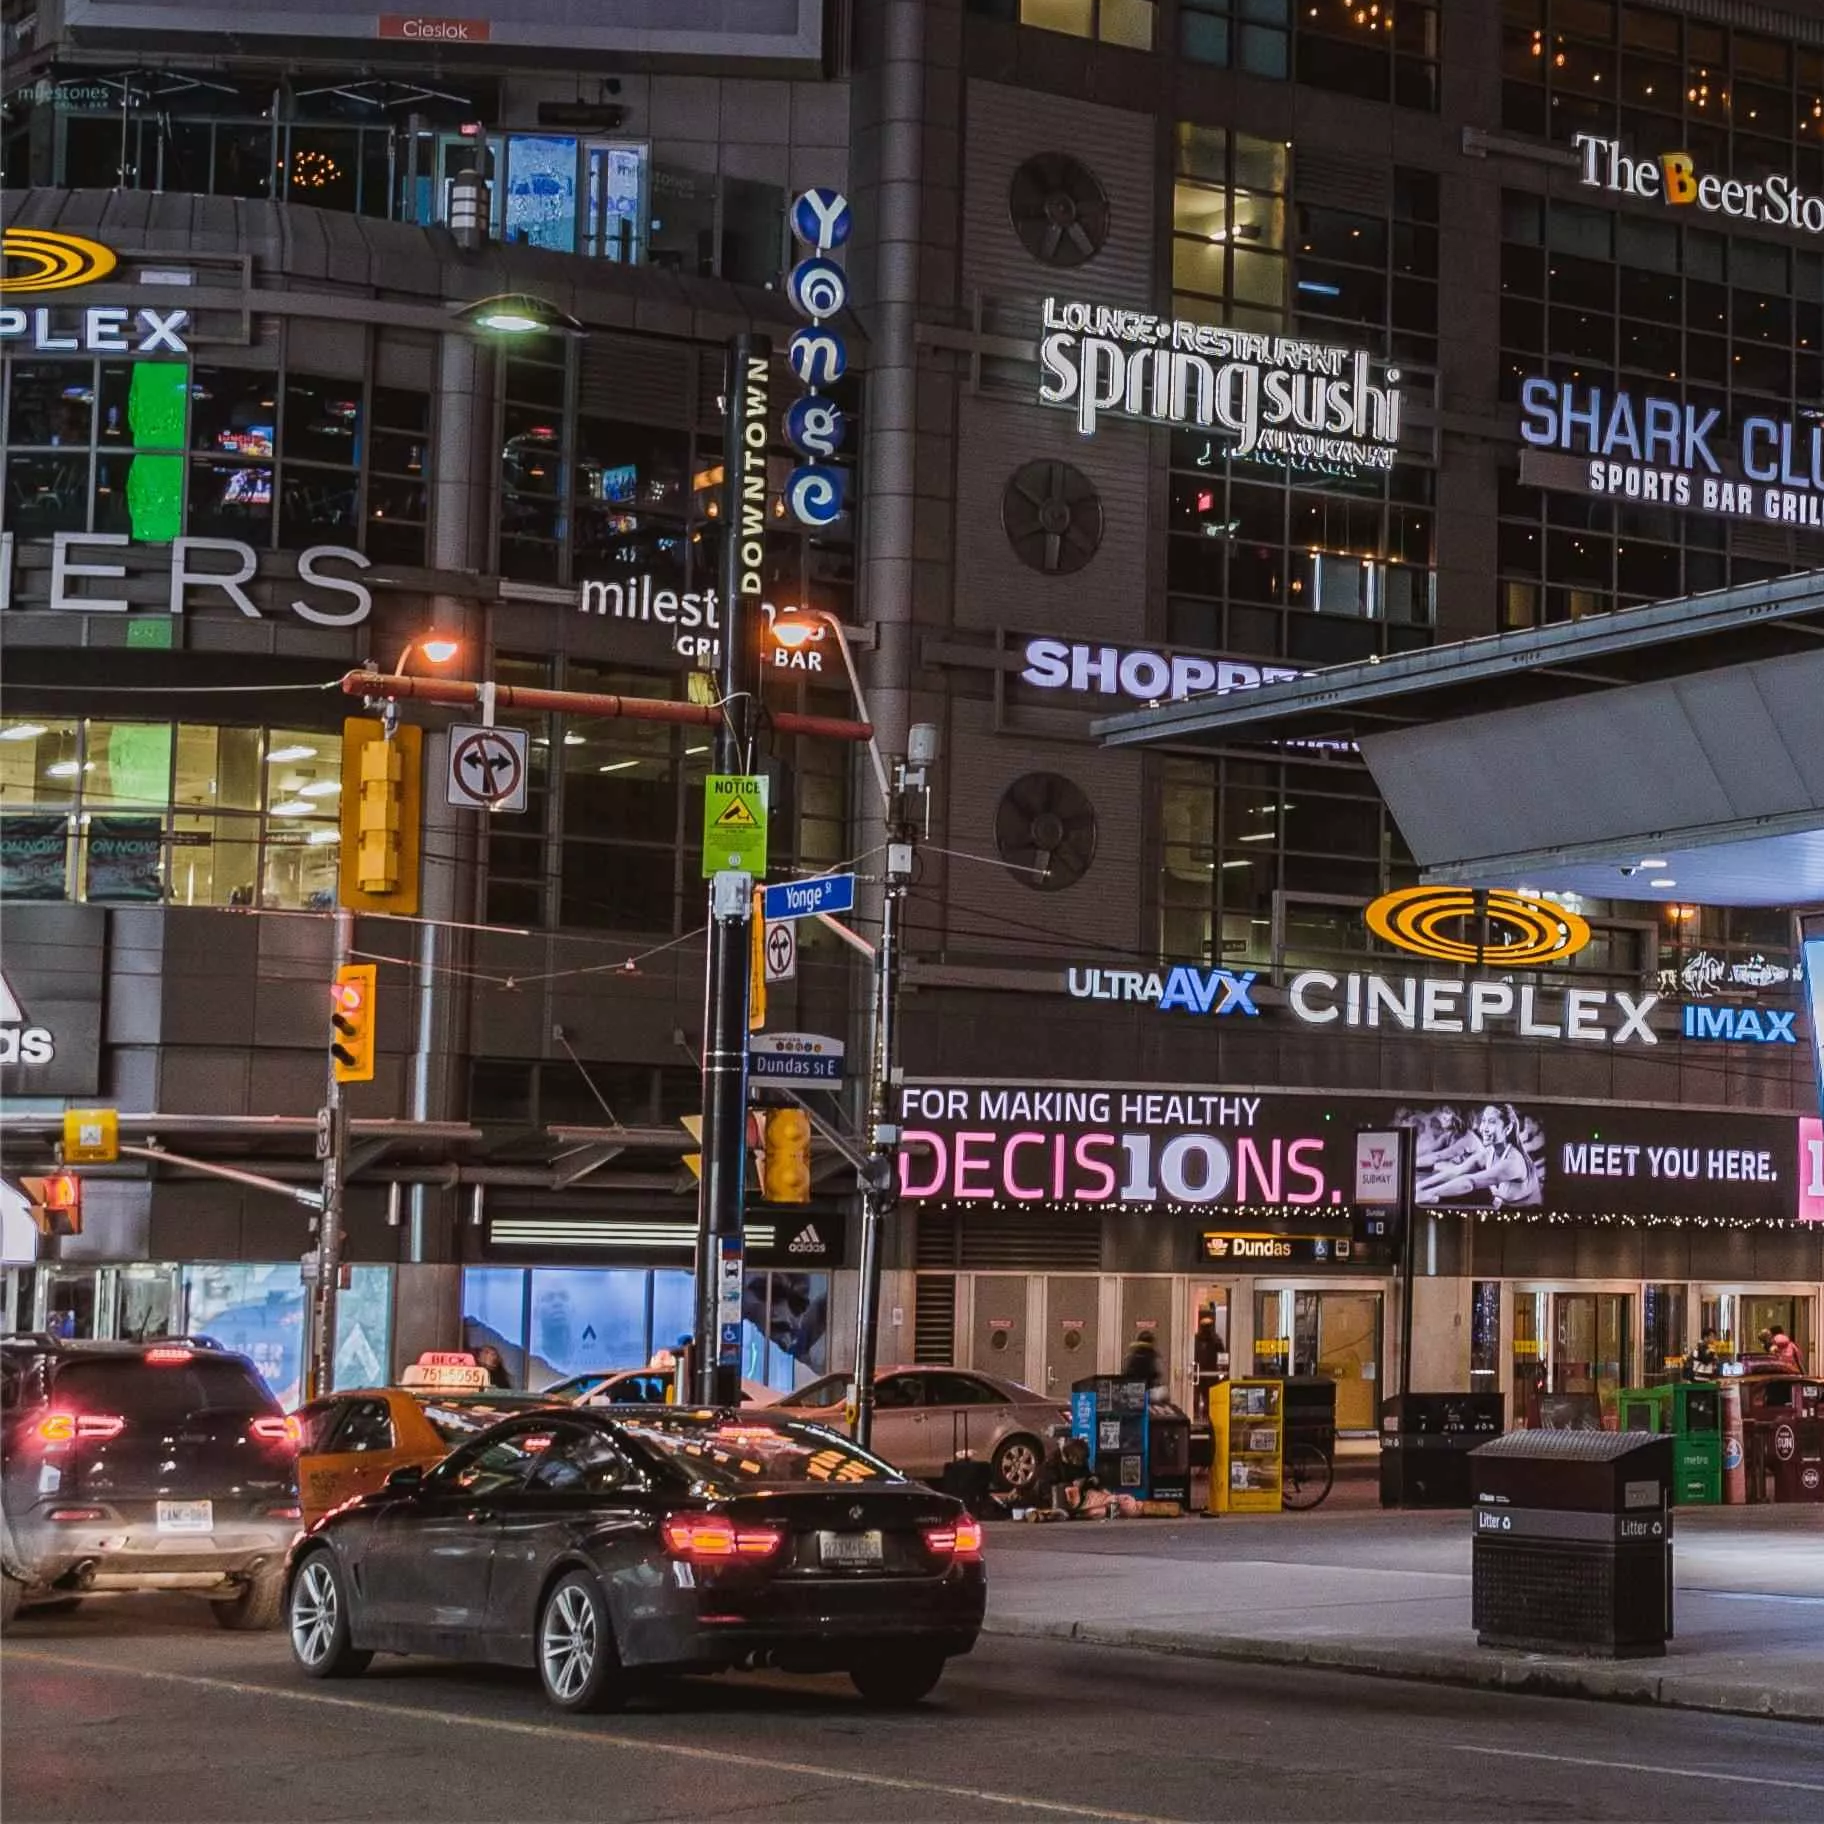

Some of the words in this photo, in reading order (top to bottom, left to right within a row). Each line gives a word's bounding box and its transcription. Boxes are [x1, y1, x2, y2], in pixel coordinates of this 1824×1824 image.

[402, 18, 468, 40] Cieslok
[1043, 296, 1158, 345] LOUNGE
[788, 187, 849, 526] Yonge
[1520, 377, 1721, 474] SHARK
[740, 356, 769, 595] DOWNTOWN
[1589, 459, 1691, 506] SPORTS
[1703, 478, 1753, 515] BAR
[676, 635, 720, 656] GRI
[774, 647, 823, 672] BAR
[714, 781, 761, 794] NOTICE
[91, 839, 115, 853] ON
[786, 886, 822, 913] Yonge
[1289, 969, 1659, 1045] CINEPLEX
[1683, 1005, 1798, 1044] IMAX
[757, 1055, 810, 1075] Dundas
[814, 1060, 825, 1075] St
[828, 1059, 836, 1075] E
[902, 1089, 968, 1121] FOR
[979, 1090, 1110, 1123] MAKING
[1120, 1094, 1262, 1127] HEALTHY
[1563, 1142, 1640, 1176] MEET
[1647, 1145, 1700, 1180] YOU
[1707, 1149, 1778, 1182] HERE.
[1232, 1238, 1291, 1257] Dundas
[1683, 1456, 1709, 1466] metro
[1480, 1512, 1500, 1529] Litter
[1621, 1519, 1647, 1536] Litter
